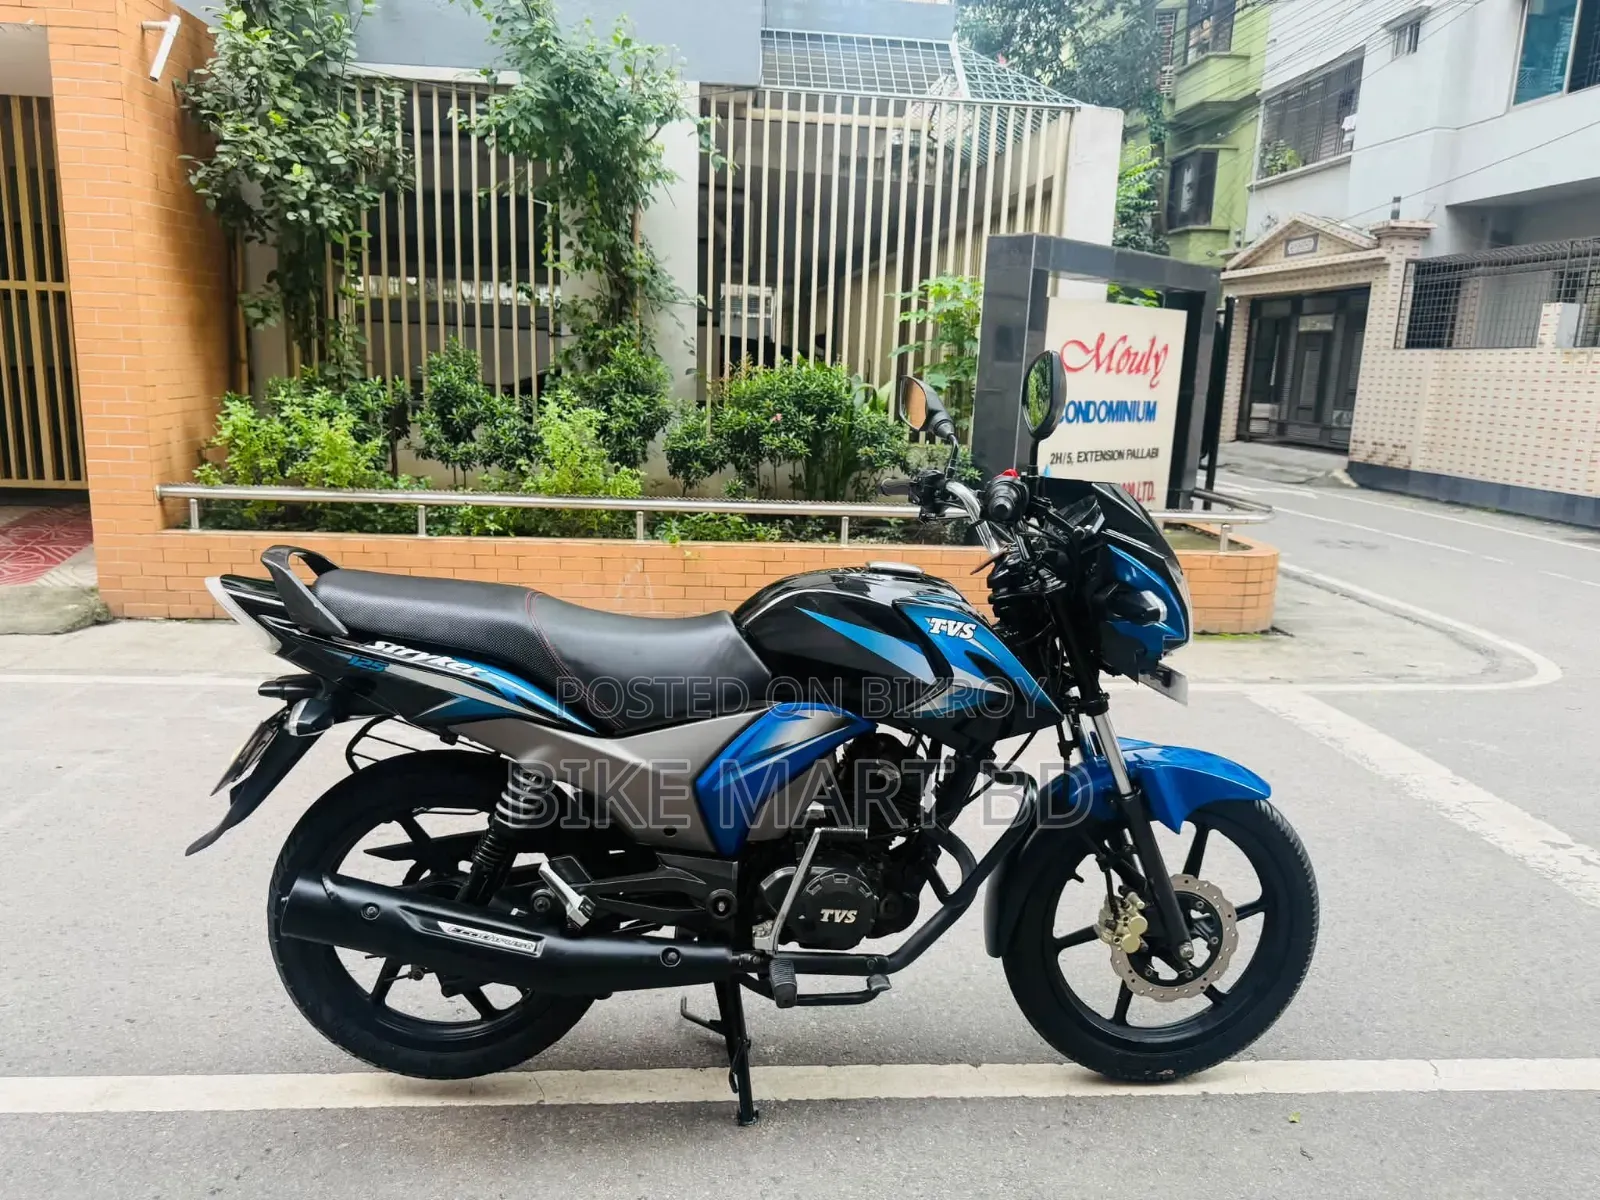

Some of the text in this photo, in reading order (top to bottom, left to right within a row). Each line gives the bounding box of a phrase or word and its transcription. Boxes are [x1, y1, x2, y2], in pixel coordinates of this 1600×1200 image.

[1060, 332, 1169, 389] Mouly
[1059, 400, 1158, 424] ONDOMINIUM
[1076, 449, 1125, 464] EXTENSION
[1125, 447, 1160, 461] PALLABI
[928, 617, 977, 640] TVS
[348, 655, 390, 673] 125
[364, 640, 489, 674] Stryker
[819, 908, 858, 924] TVS
